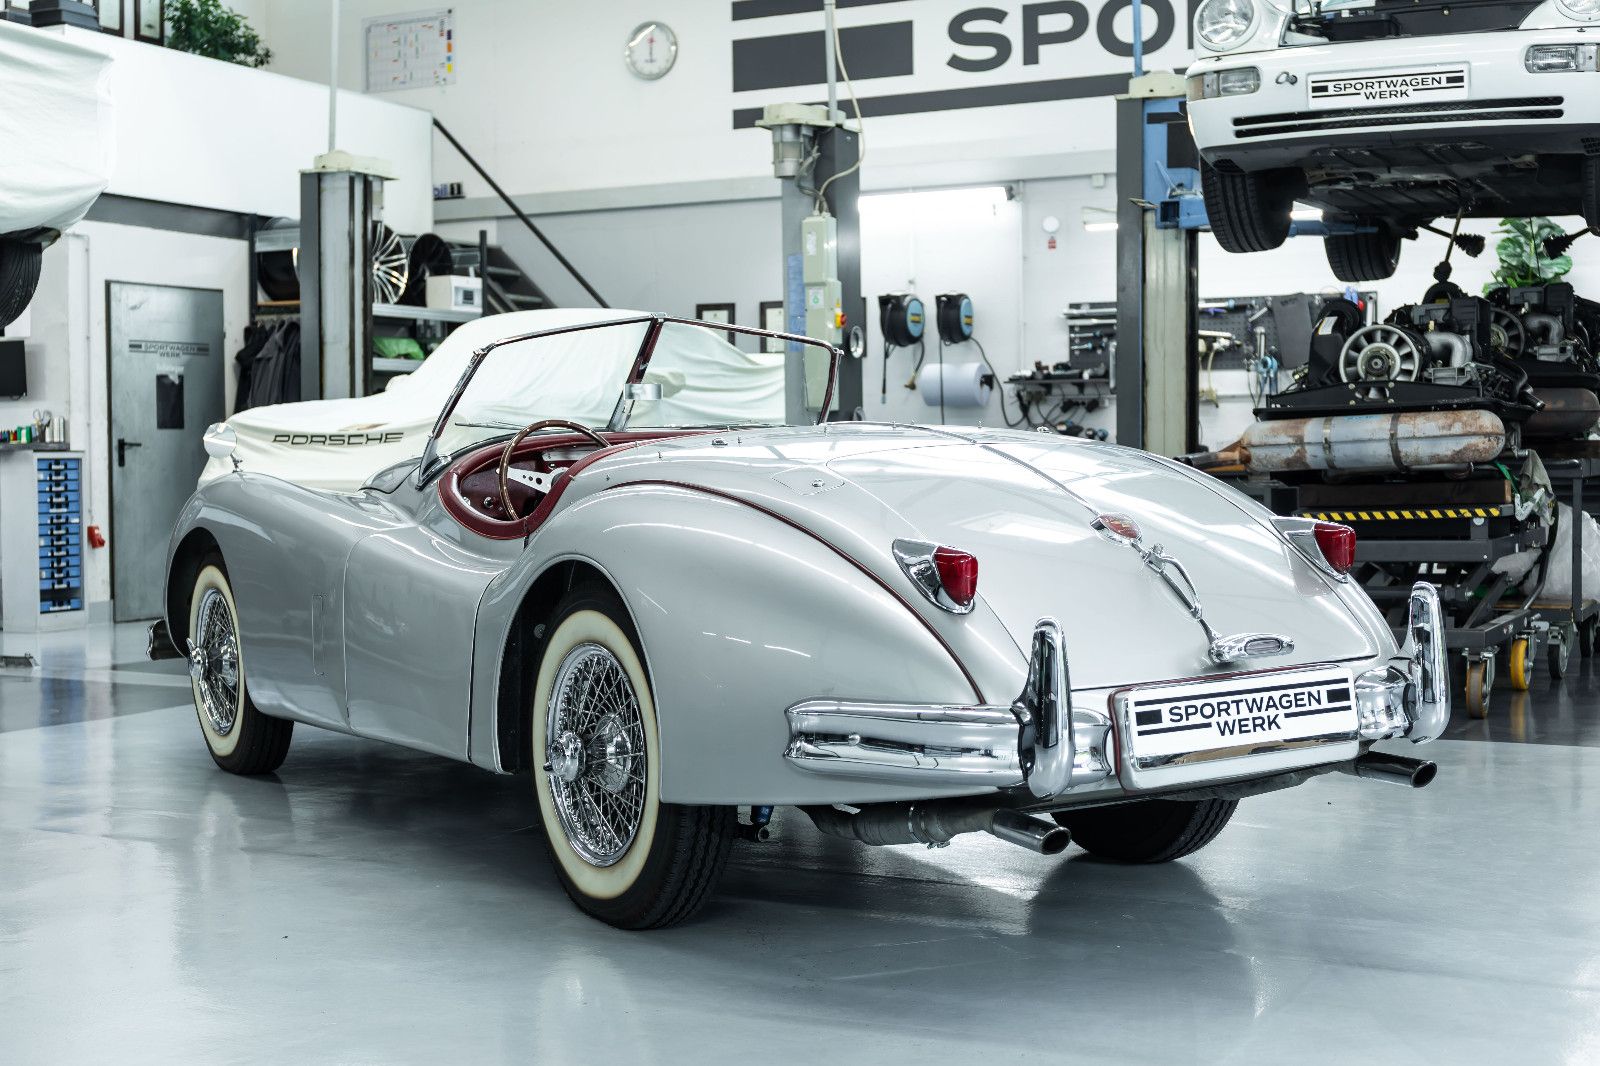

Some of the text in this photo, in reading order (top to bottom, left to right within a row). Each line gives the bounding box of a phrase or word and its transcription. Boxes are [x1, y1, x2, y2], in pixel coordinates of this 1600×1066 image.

[947, 0, 1202, 72] SPO
[1333, 77, 1442, 93] SPORTWAGEN
[1364, 89, 1410, 100] WERK
[144, 343, 196, 352] SPORTWAGEN
[272, 432, 404, 445] PORSCHE
[1168, 690, 1322, 723] SPORTWAGEN
[1216, 714, 1282, 737] WERK
